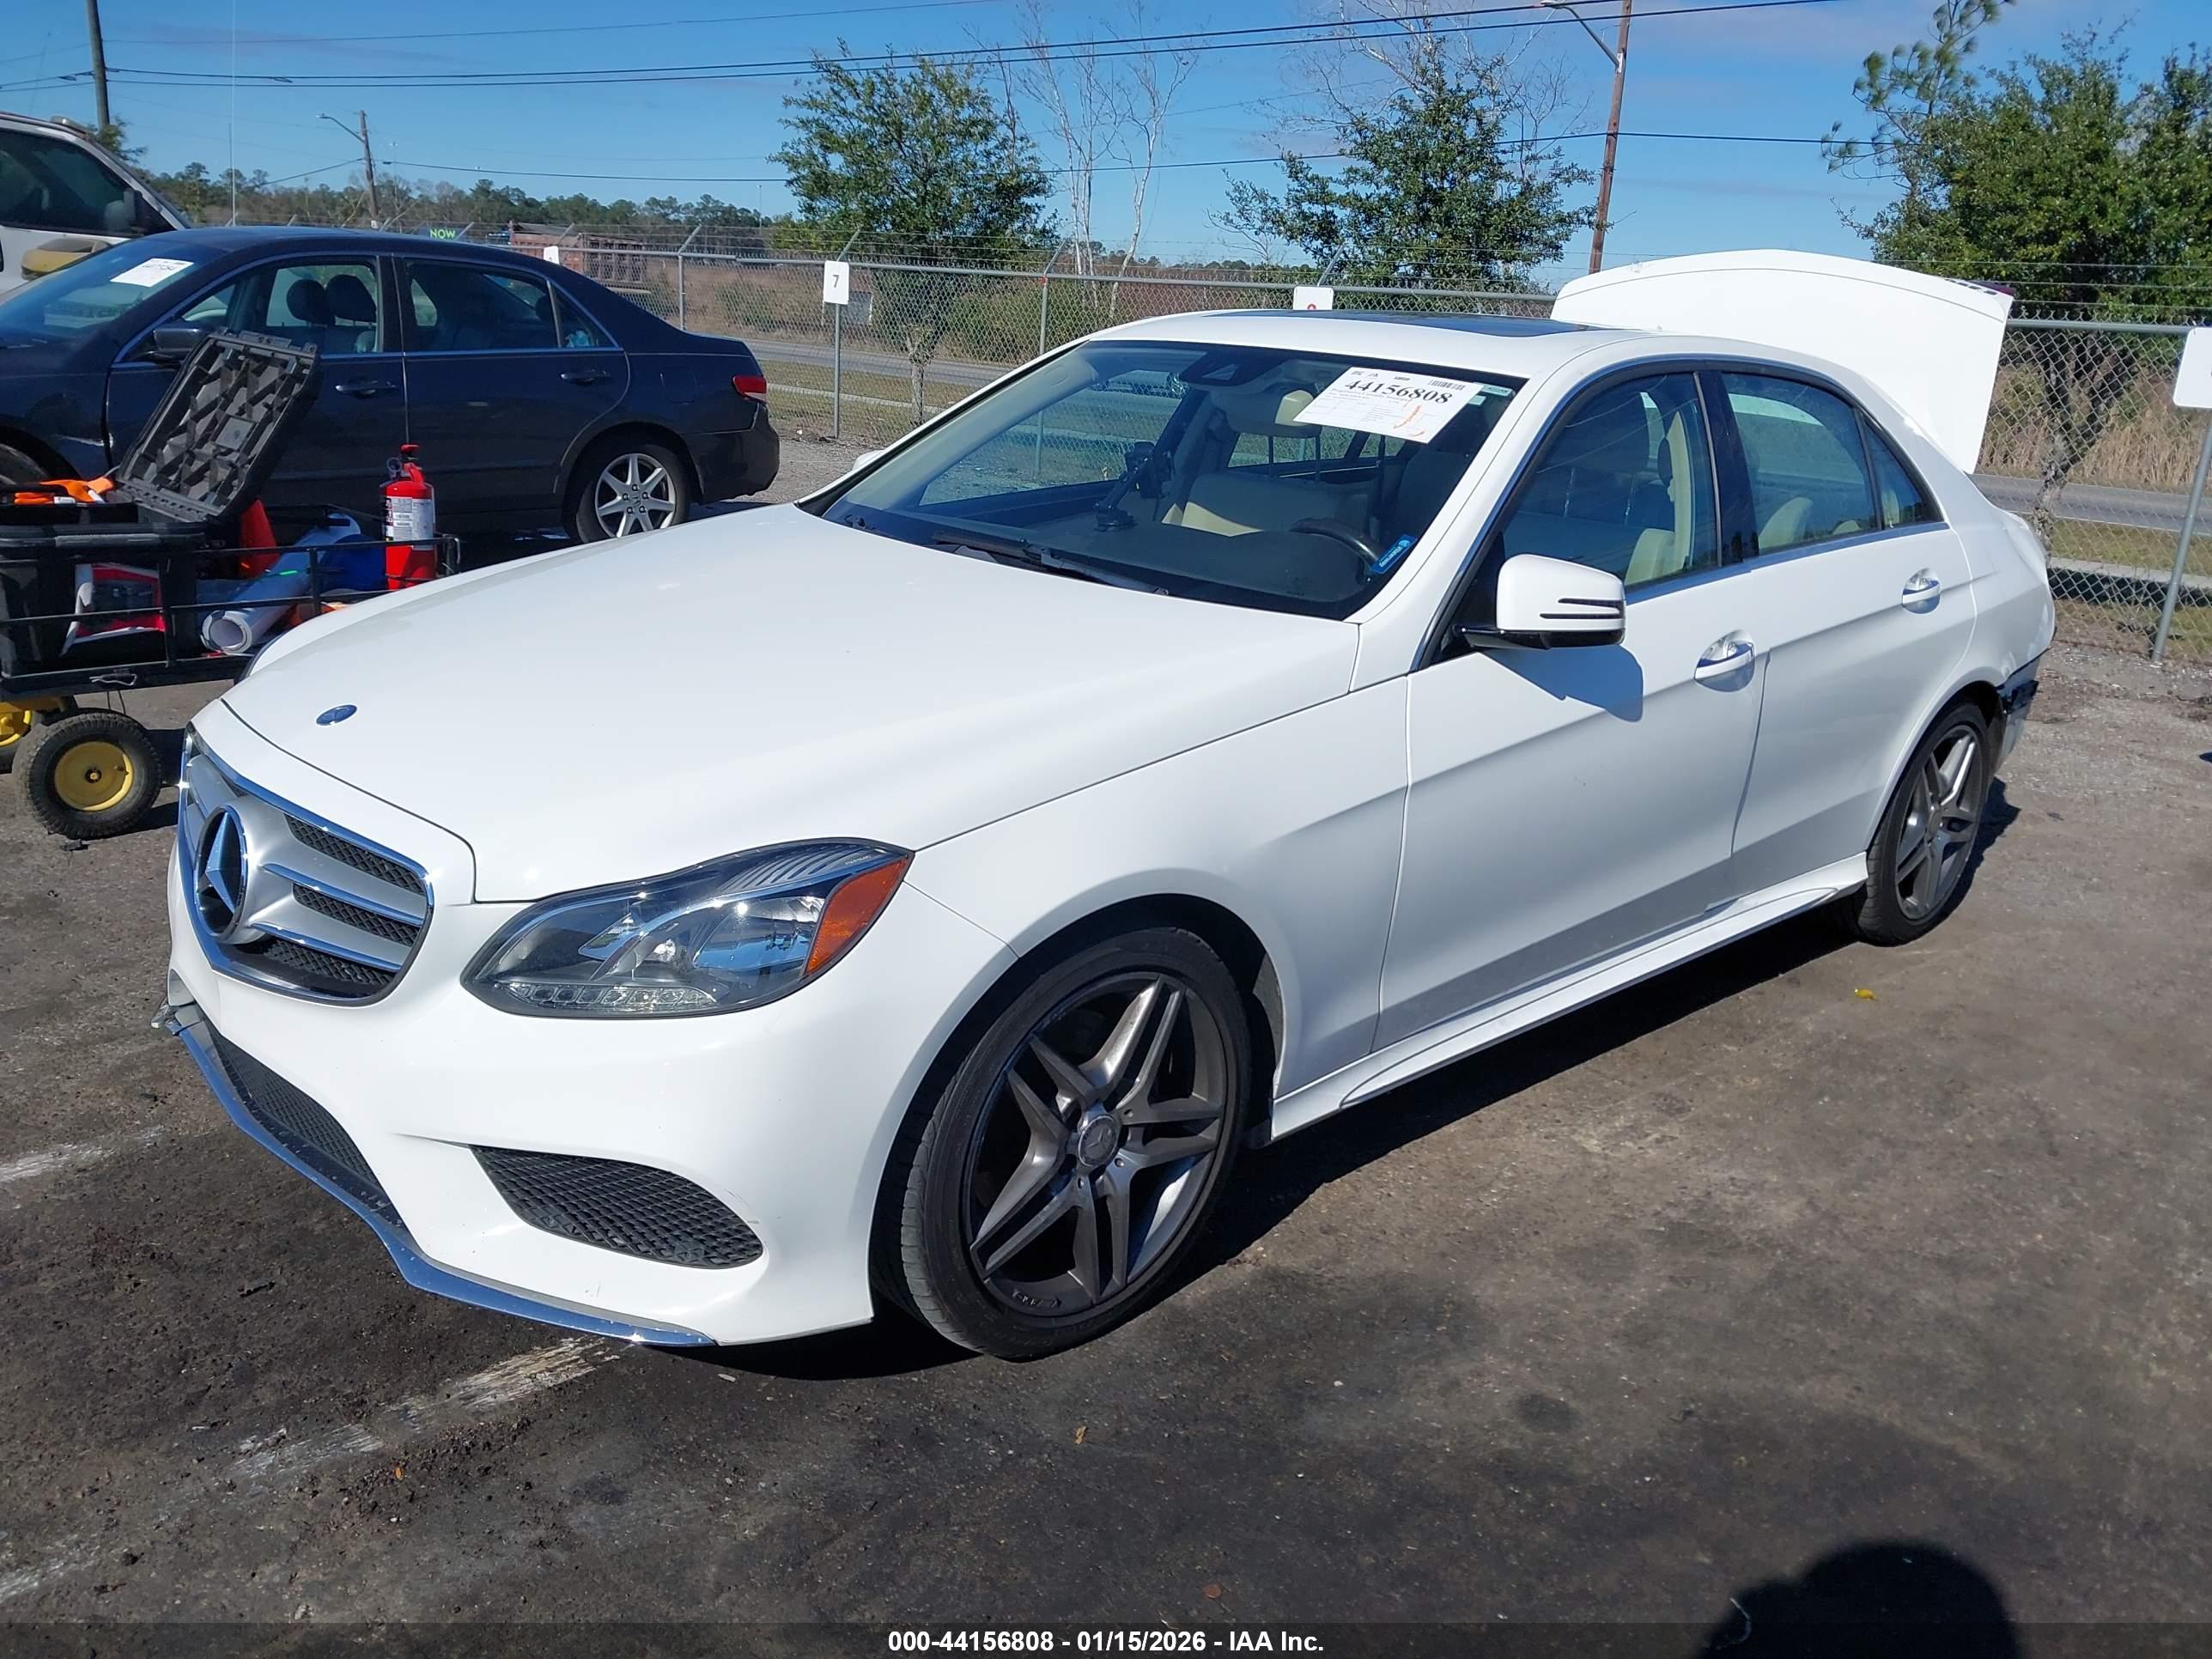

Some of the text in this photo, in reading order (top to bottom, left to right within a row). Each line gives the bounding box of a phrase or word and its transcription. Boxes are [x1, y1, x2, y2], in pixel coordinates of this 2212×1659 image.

[429, 228, 455, 239] NOW
[832, 275, 840, 288] 7
[1344, 380, 1453, 404] 44156808
